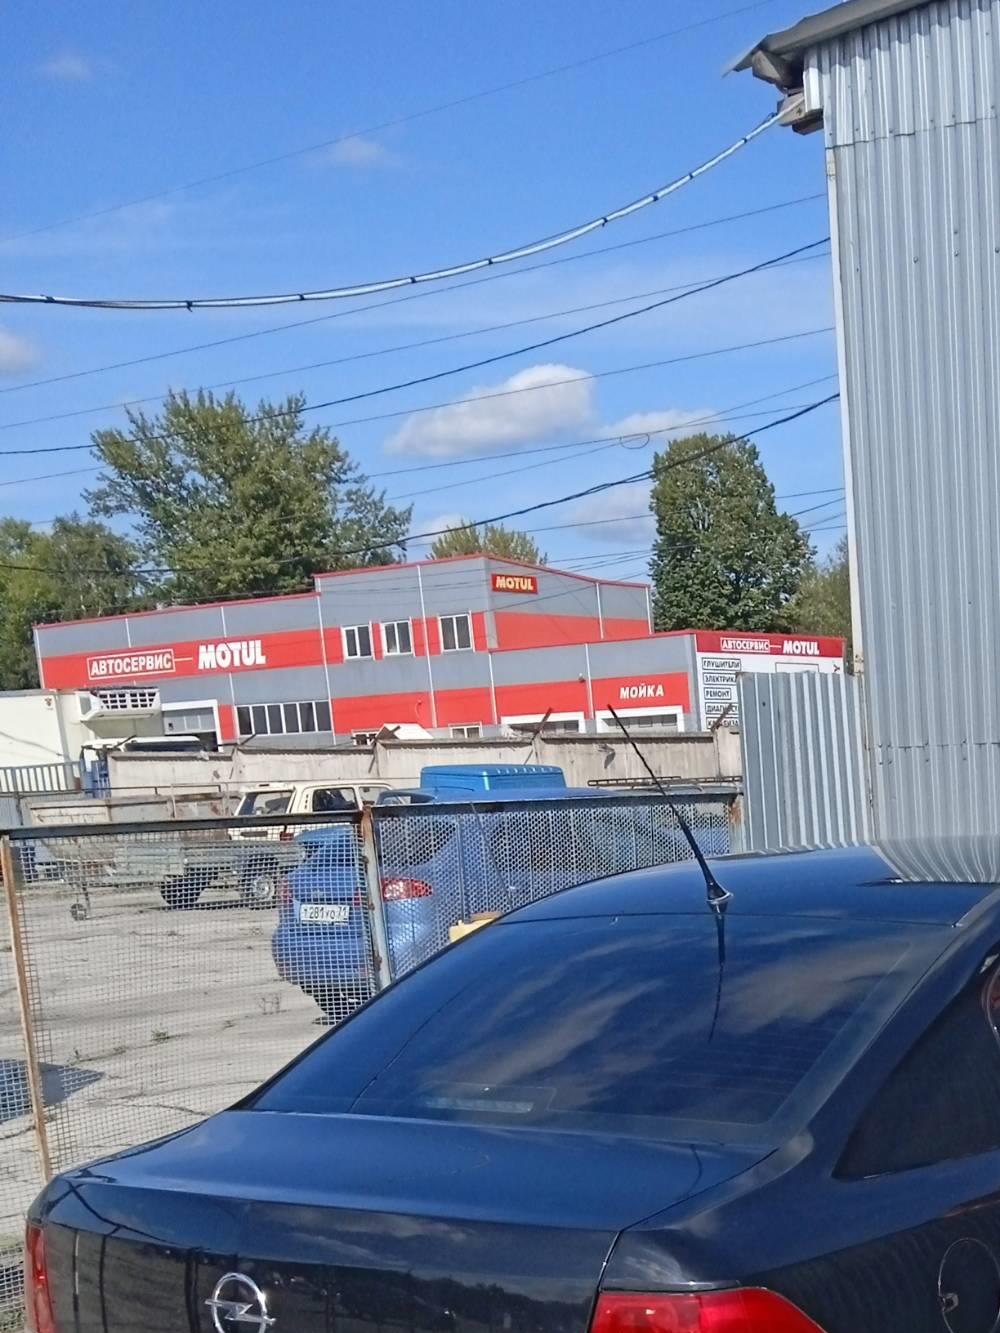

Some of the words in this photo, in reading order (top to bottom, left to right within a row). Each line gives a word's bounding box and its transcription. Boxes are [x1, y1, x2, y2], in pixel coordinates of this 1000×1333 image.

[495, 575, 533, 591] MOTUL
[722, 640, 769, 650] АВТОСЕРВИС
[783, 640, 819, 655] MOTUL
[90, 658, 172, 677] АВТОСЕРВИС
[198, 640, 266, 670] MOTUL
[619, 684, 664, 699] МОЙКА
